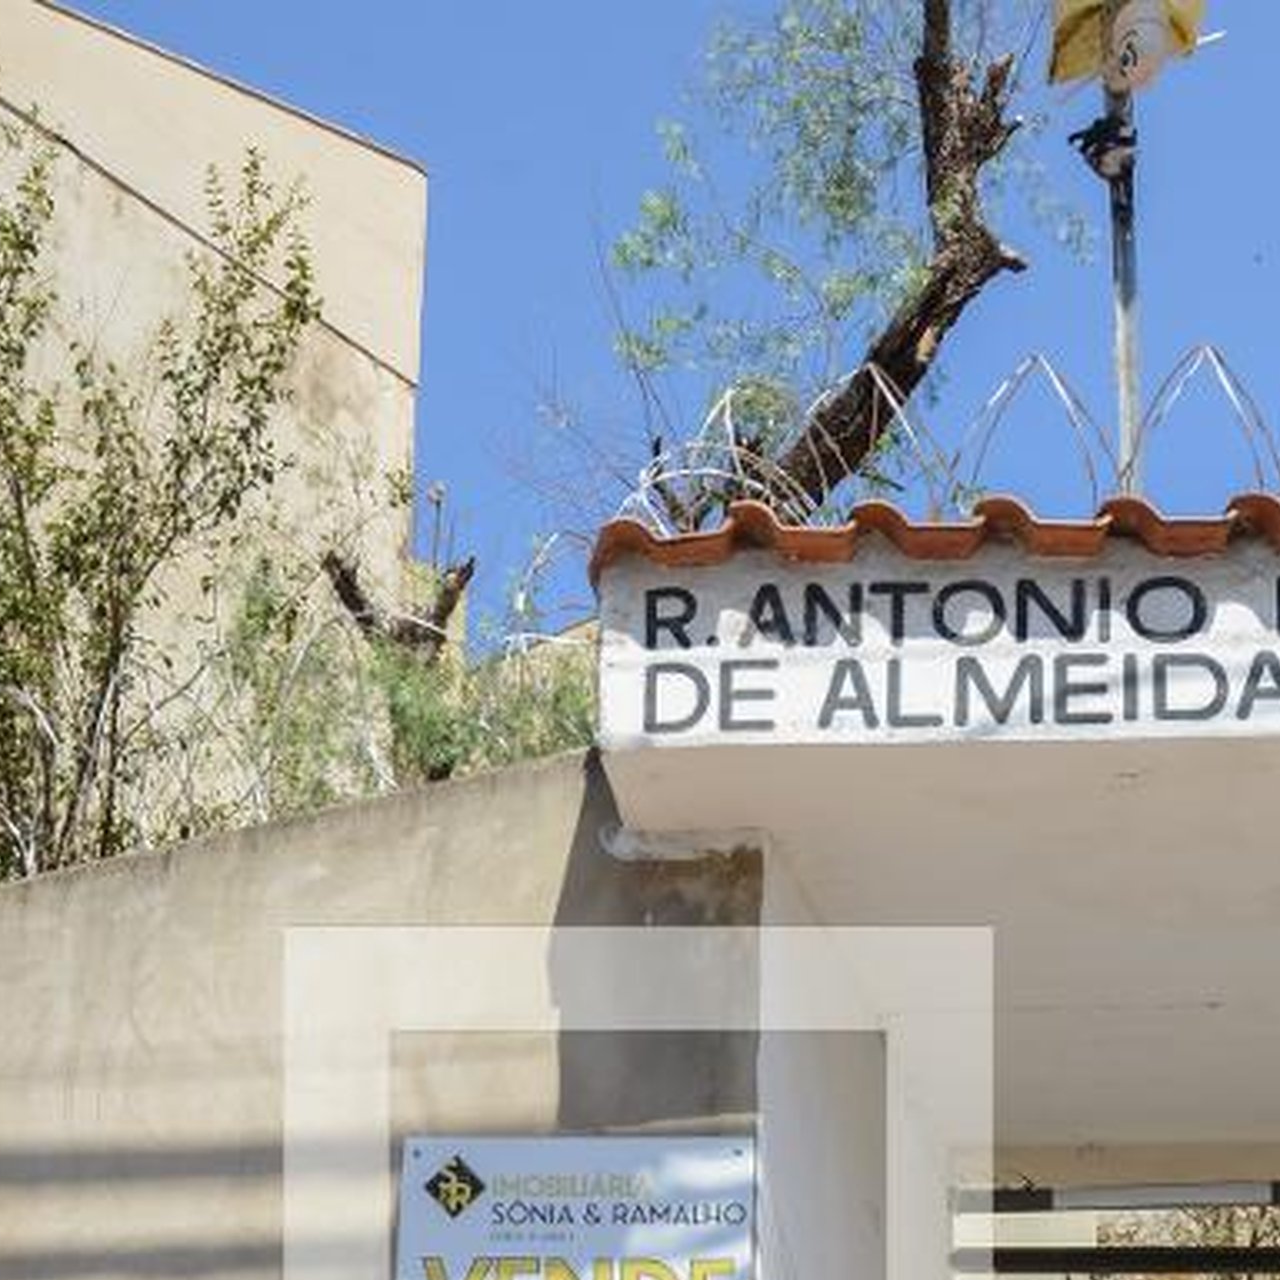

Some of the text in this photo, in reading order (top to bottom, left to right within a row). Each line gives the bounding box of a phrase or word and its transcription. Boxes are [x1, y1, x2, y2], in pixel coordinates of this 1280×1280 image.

[644, 659, 779, 733] DE
[583, 1202, 602, 1225] &
[613, 1202, 747, 1224] RAMALHO
